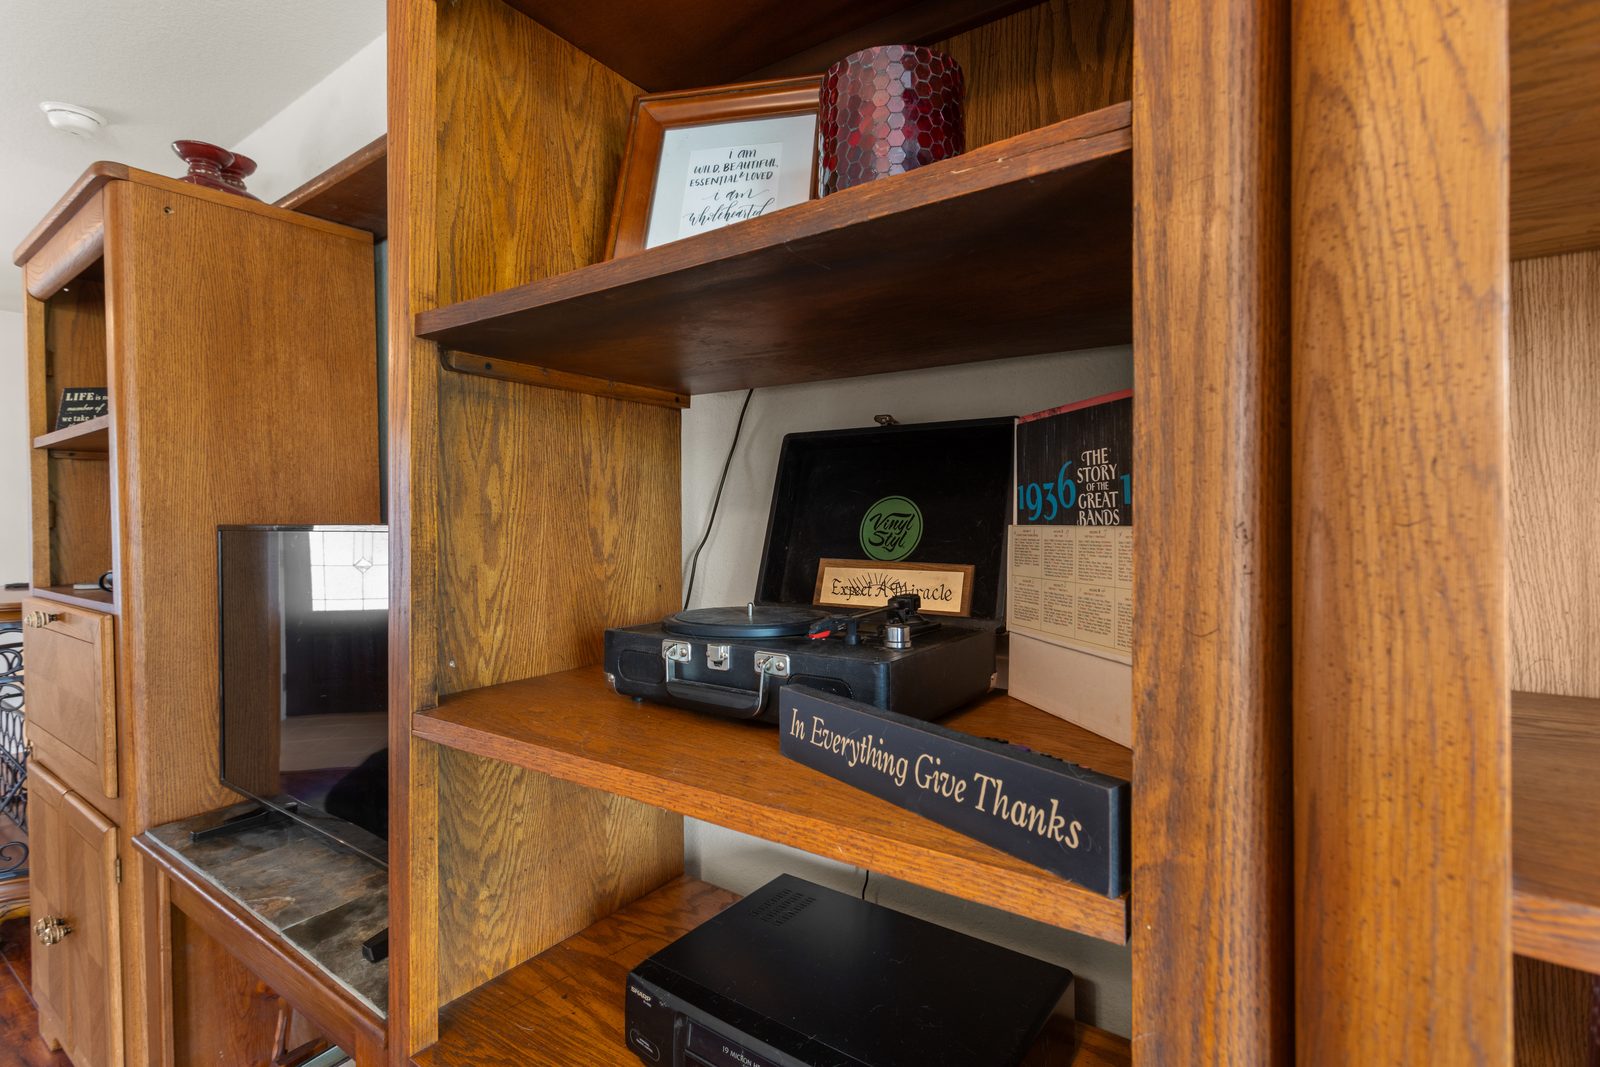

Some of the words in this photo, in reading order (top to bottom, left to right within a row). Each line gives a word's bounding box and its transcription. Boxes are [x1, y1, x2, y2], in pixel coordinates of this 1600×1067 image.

[737, 149, 757, 159] am
[723, 158, 779, 173] BEAUTIFUL,
[689, 174, 738, 187] ESSENTIAL
[746, 171, 774, 180] LOVED
[65, 392, 95, 402] LIFE
[66, 404, 94, 412] number
[94, 403, 106, 414] of
[73, 414, 90, 423] take
[1081, 447, 1109, 467] THE
[1076, 463, 1118, 484] STORY
[1018, 460, 1077, 521] 1936
[1086, 482, 1096, 491] OF
[1097, 481, 1110, 491] THE
[1078, 490, 1119, 510] GREAT
[869, 512, 916, 535] Vinyl
[1077, 508, 1121, 526] BANDS
[868, 530, 908, 553] Styl
[831, 578, 872, 600] Expect
[874, 578, 889, 598] A
[890, 581, 953, 602] Miracle
[789, 708, 806, 740] In
[809, 715, 909, 787] Everything
[914, 754, 967, 802] Give
[973, 772, 1084, 849] Thanks
[722, 1045, 730, 1054] 19
